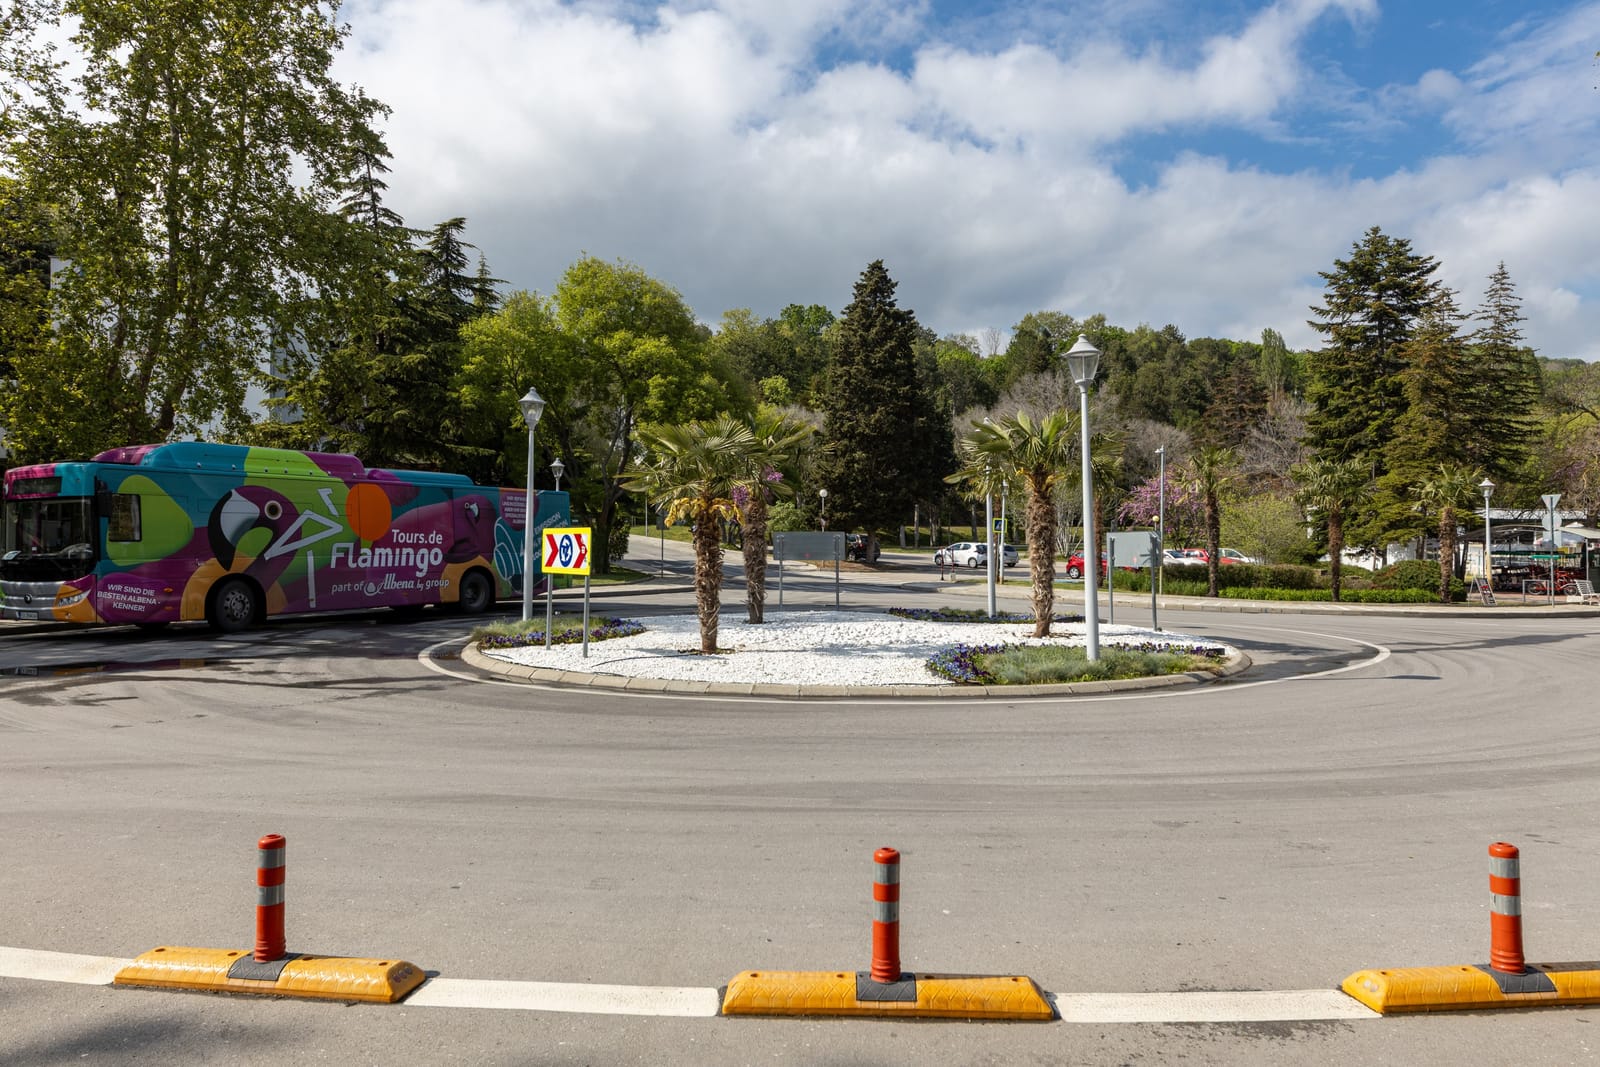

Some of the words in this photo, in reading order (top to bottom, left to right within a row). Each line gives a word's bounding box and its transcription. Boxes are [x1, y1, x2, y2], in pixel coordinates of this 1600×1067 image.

[391, 529, 443, 544] Tours.de
[330, 542, 444, 577] Flamingo
[124, 586, 142, 595] SIND
[142, 588, 155, 596] DIE
[331, 583, 352, 595] part
[353, 581, 365, 592] of
[416, 579, 424, 591] by
[425, 579, 450, 590] group
[97, 591, 127, 601] BESTEN
[127, 595, 157, 605] ALBENA
[112, 601, 146, 612] KENNER!
